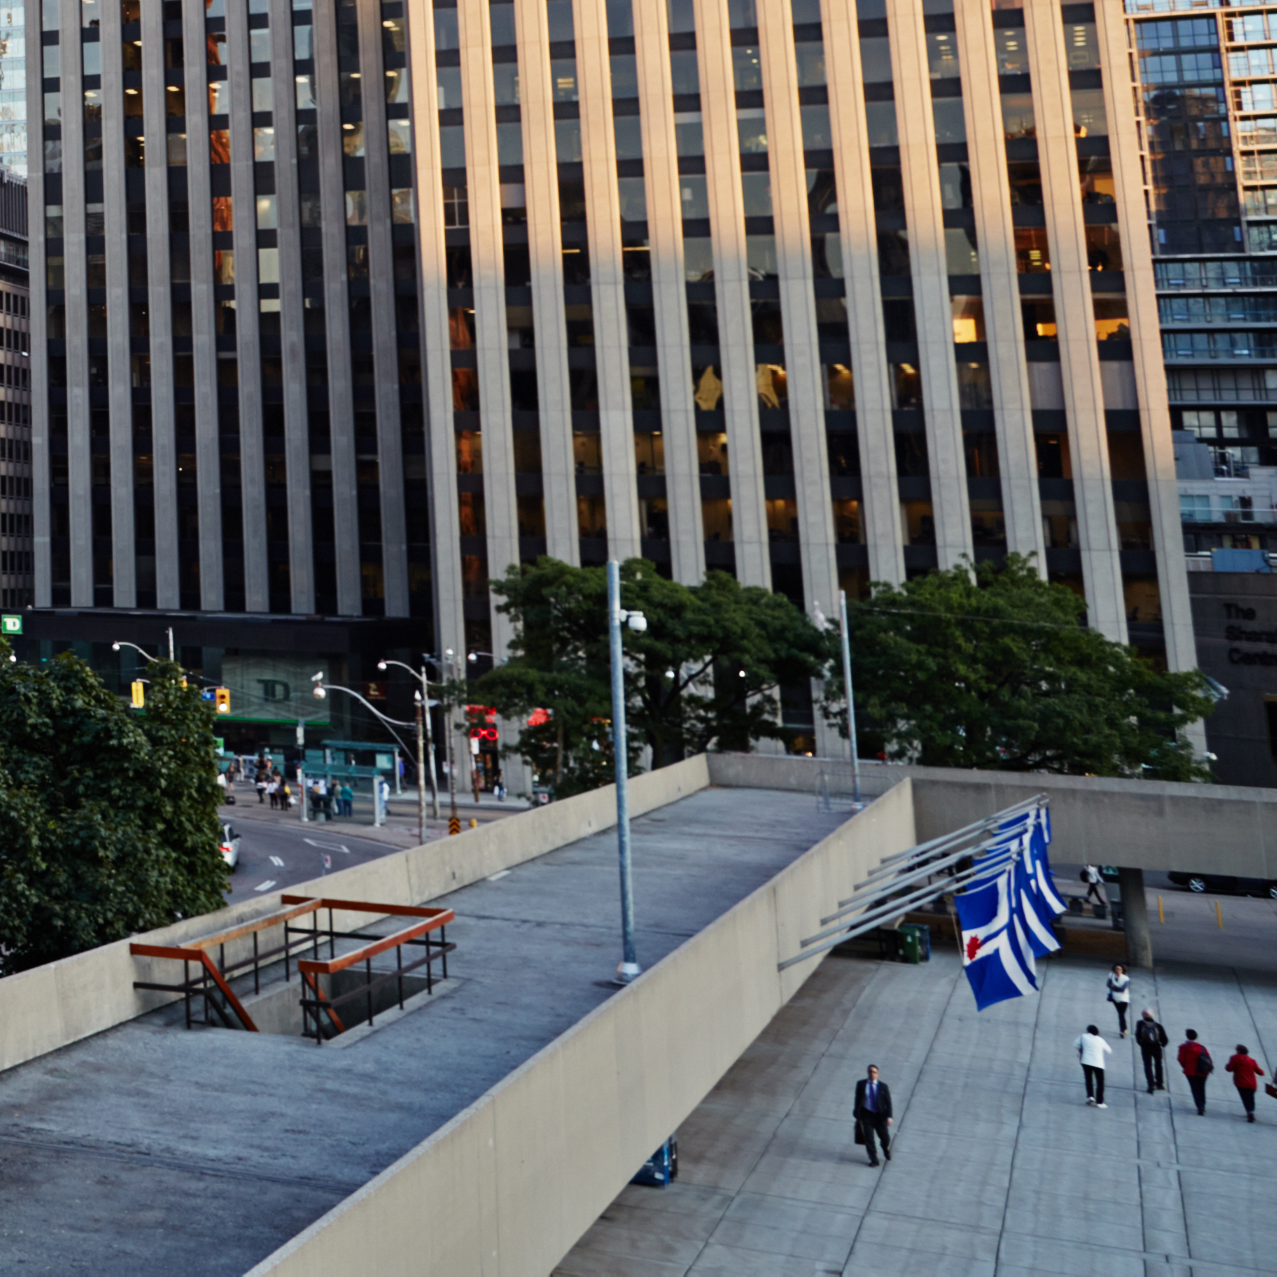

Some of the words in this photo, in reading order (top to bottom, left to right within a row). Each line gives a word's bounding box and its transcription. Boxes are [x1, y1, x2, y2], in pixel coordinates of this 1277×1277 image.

[1223, 603, 1256, 620] The
[4, 617, 20, 631] TD
[1225, 625, 1277, 643] Shera
[1228, 647, 1277, 666] Centr
[257, 678, 290, 703] TD
